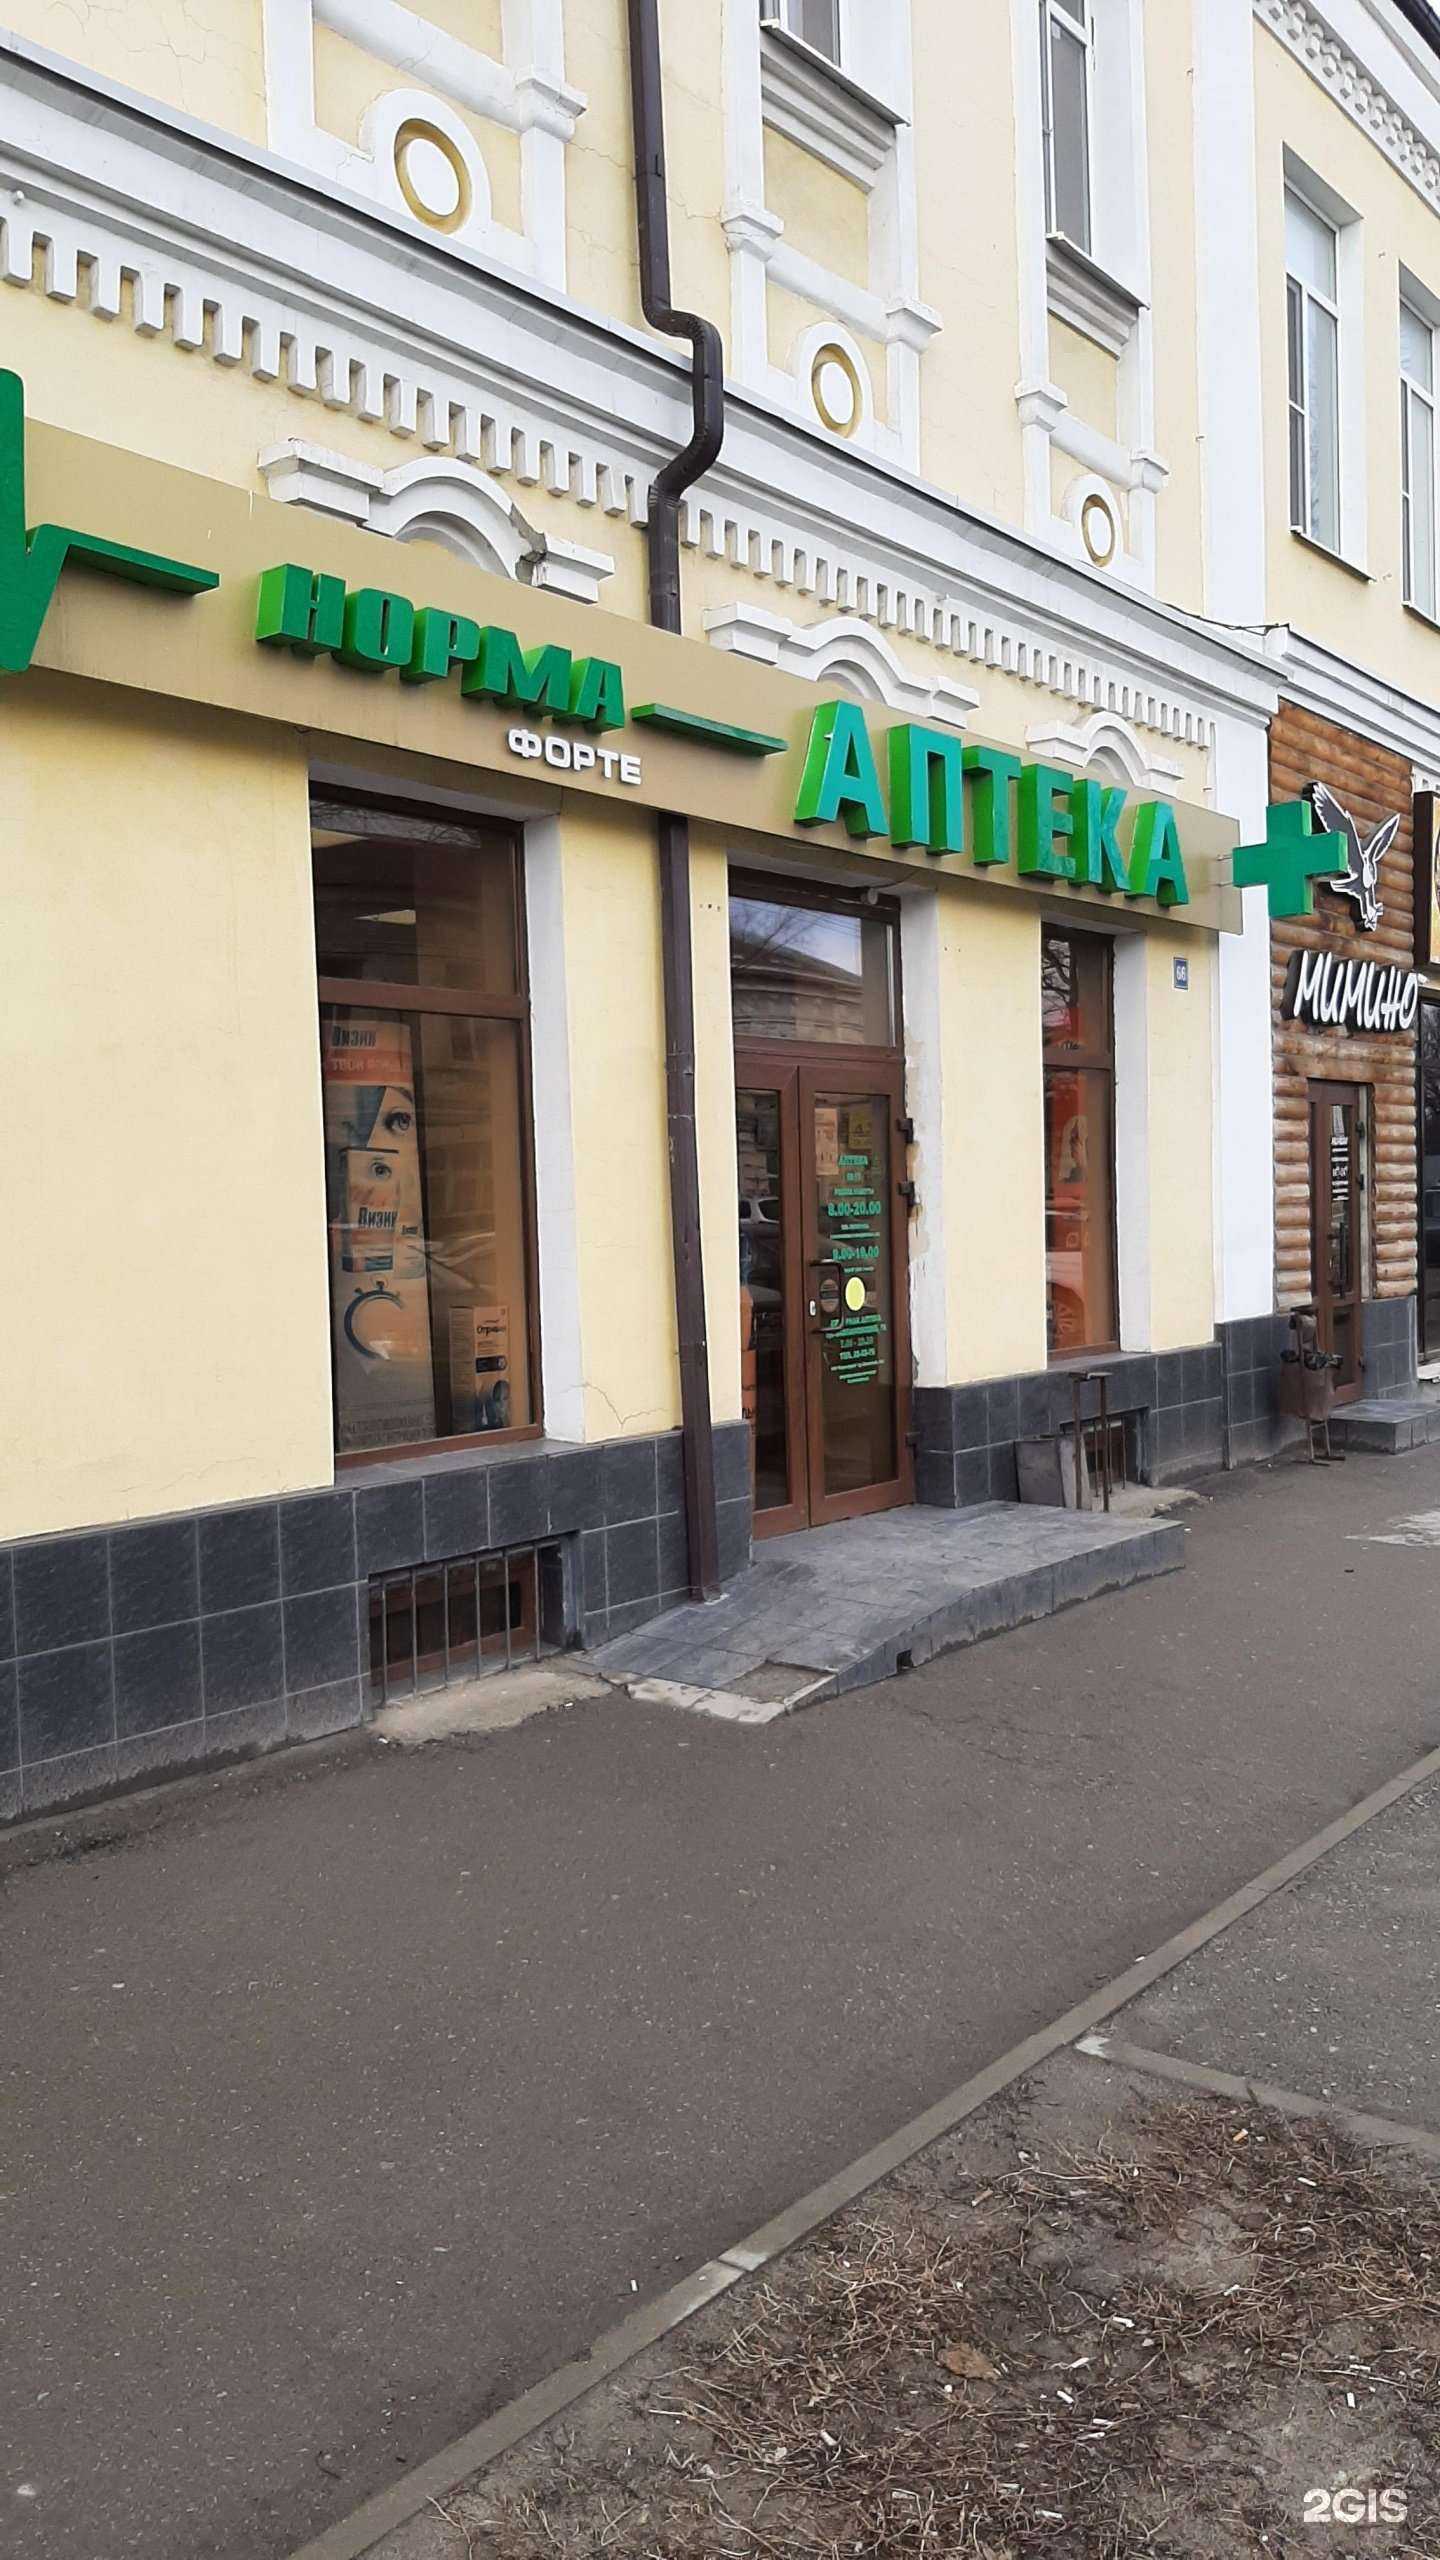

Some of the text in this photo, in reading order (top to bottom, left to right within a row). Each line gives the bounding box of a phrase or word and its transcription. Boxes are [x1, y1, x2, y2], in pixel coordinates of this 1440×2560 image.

[257, 563, 626, 731] НОРМА
[507, 727, 642, 786] ФОРТЕ
[794, 699, 1190, 907] АПТЕКА
[1293, 949, 1419, 1031] МИМИНО
